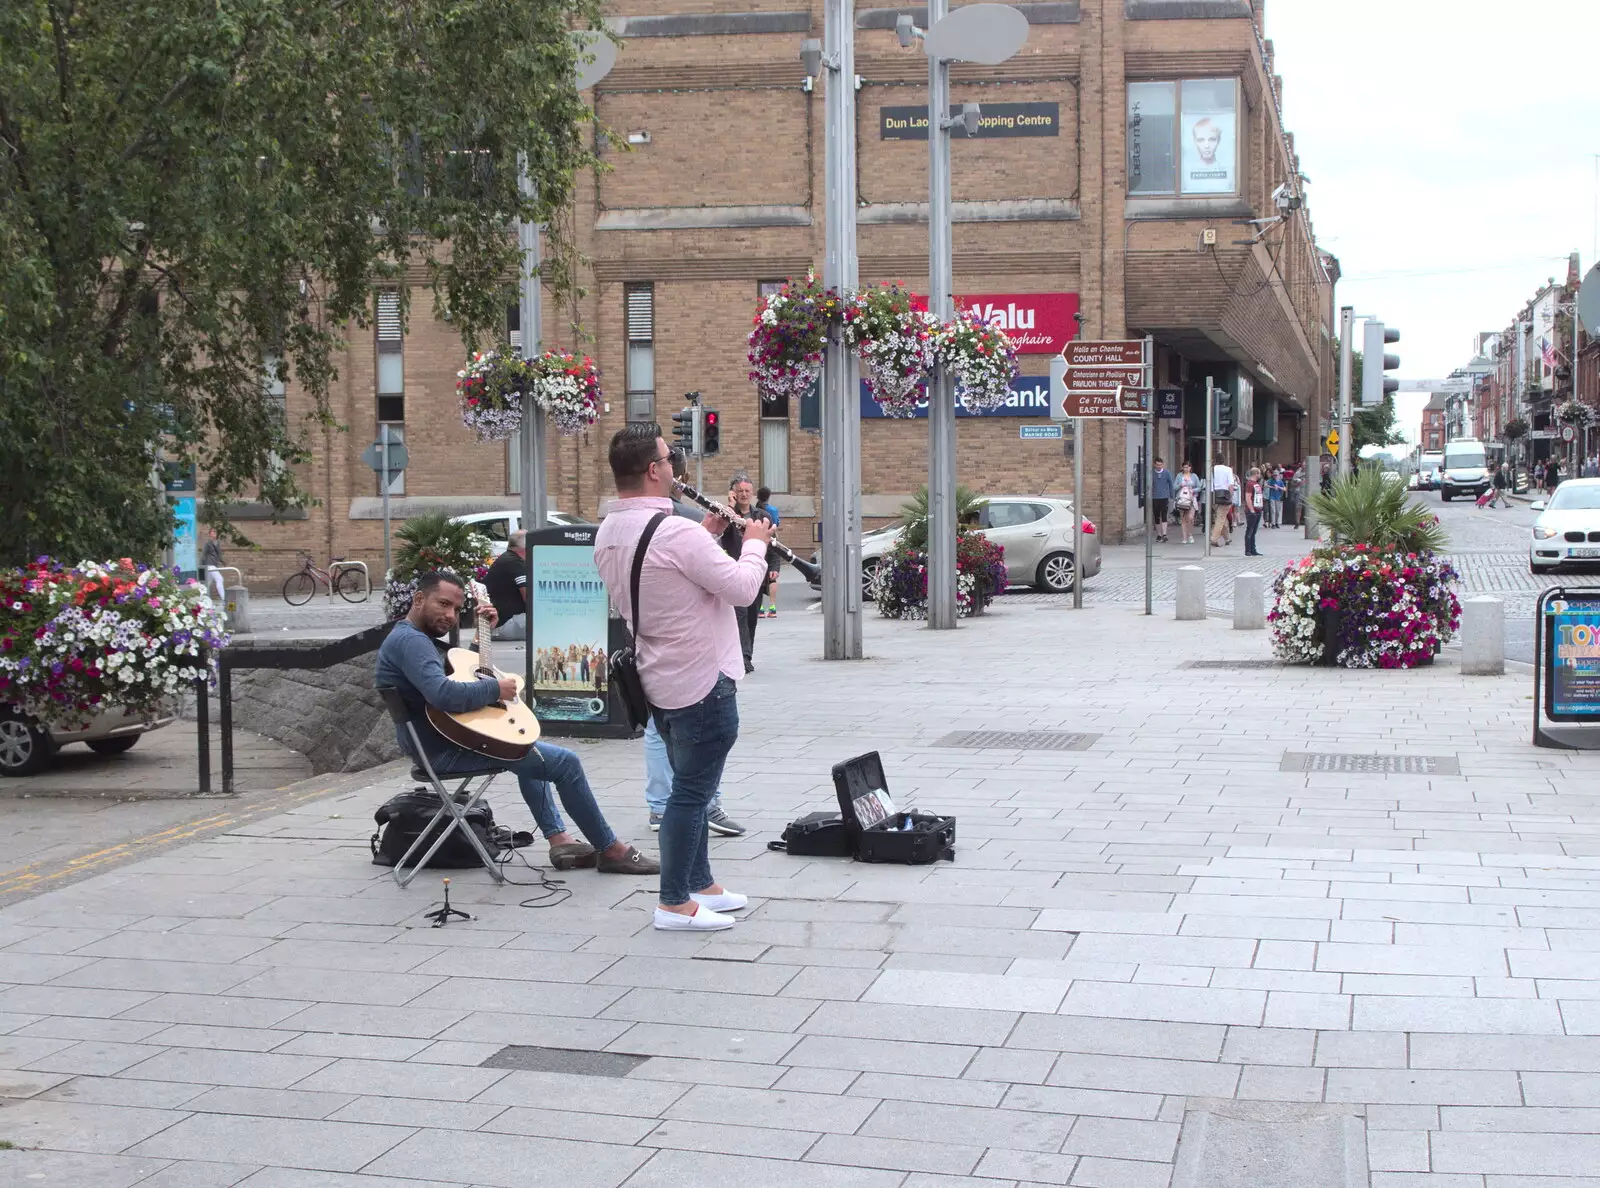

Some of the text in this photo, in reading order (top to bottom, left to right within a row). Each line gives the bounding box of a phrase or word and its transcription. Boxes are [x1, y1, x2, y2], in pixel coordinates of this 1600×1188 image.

[885, 117, 907, 129] Dun
[977, 114, 1014, 127] opping
[1016, 114, 1052, 125] Centre
[1073, 353, 1123, 363] COUNTY HALL
[1072, 380, 1122, 388] PAVILION THEATRE
[1005, 385, 1049, 407] ank
[1079, 406, 1120, 414] EAST PIER
[538, 580, 576, 595] MAMMA
